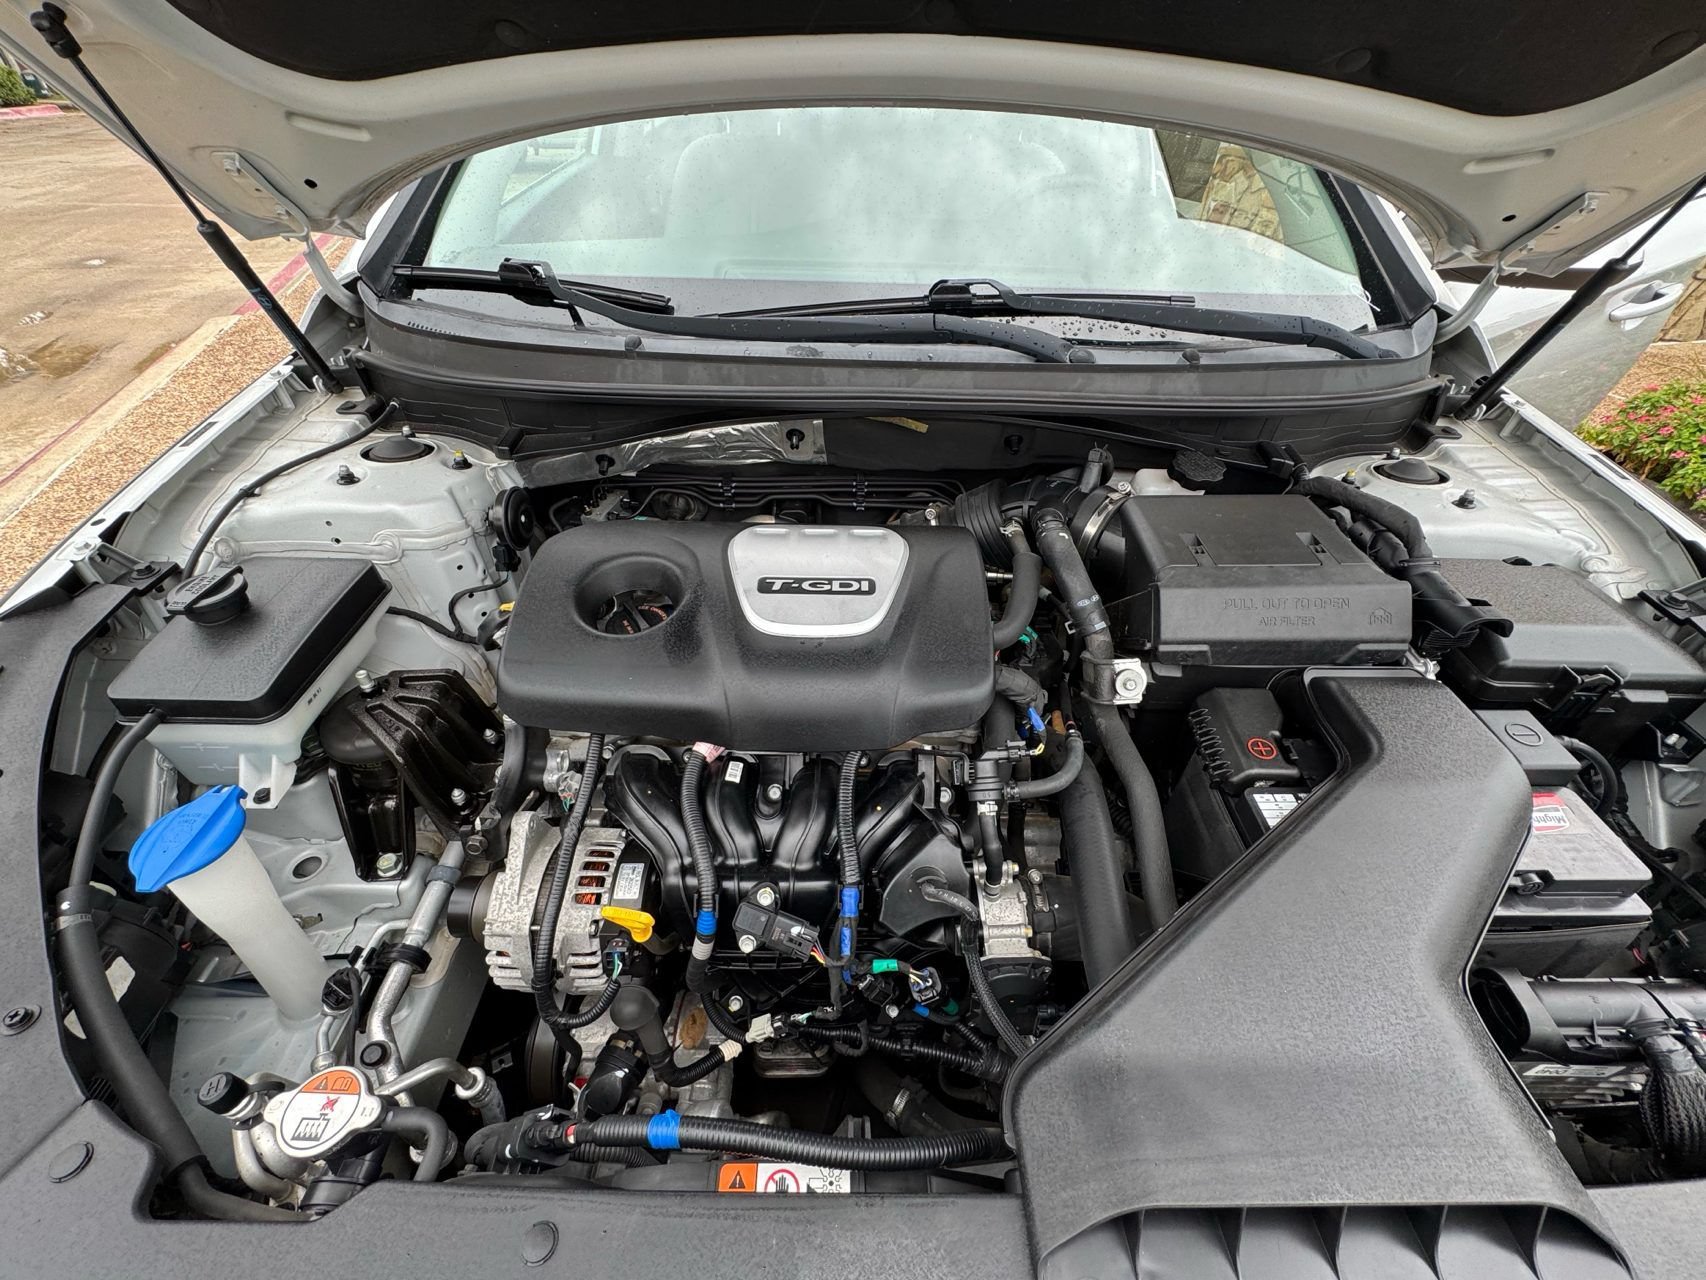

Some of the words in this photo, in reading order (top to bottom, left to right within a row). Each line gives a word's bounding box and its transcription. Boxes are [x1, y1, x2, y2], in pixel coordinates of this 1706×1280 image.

[765, 579, 869, 591] T-GDI
[1223, 598, 1257, 610] PULL
[1262, 598, 1288, 609] OUT
[1294, 598, 1310, 609] TO
[1314, 598, 1350, 609] OPEN
[1258, 616, 1277, 626] AIR
[1279, 615, 1316, 626] FILTER
